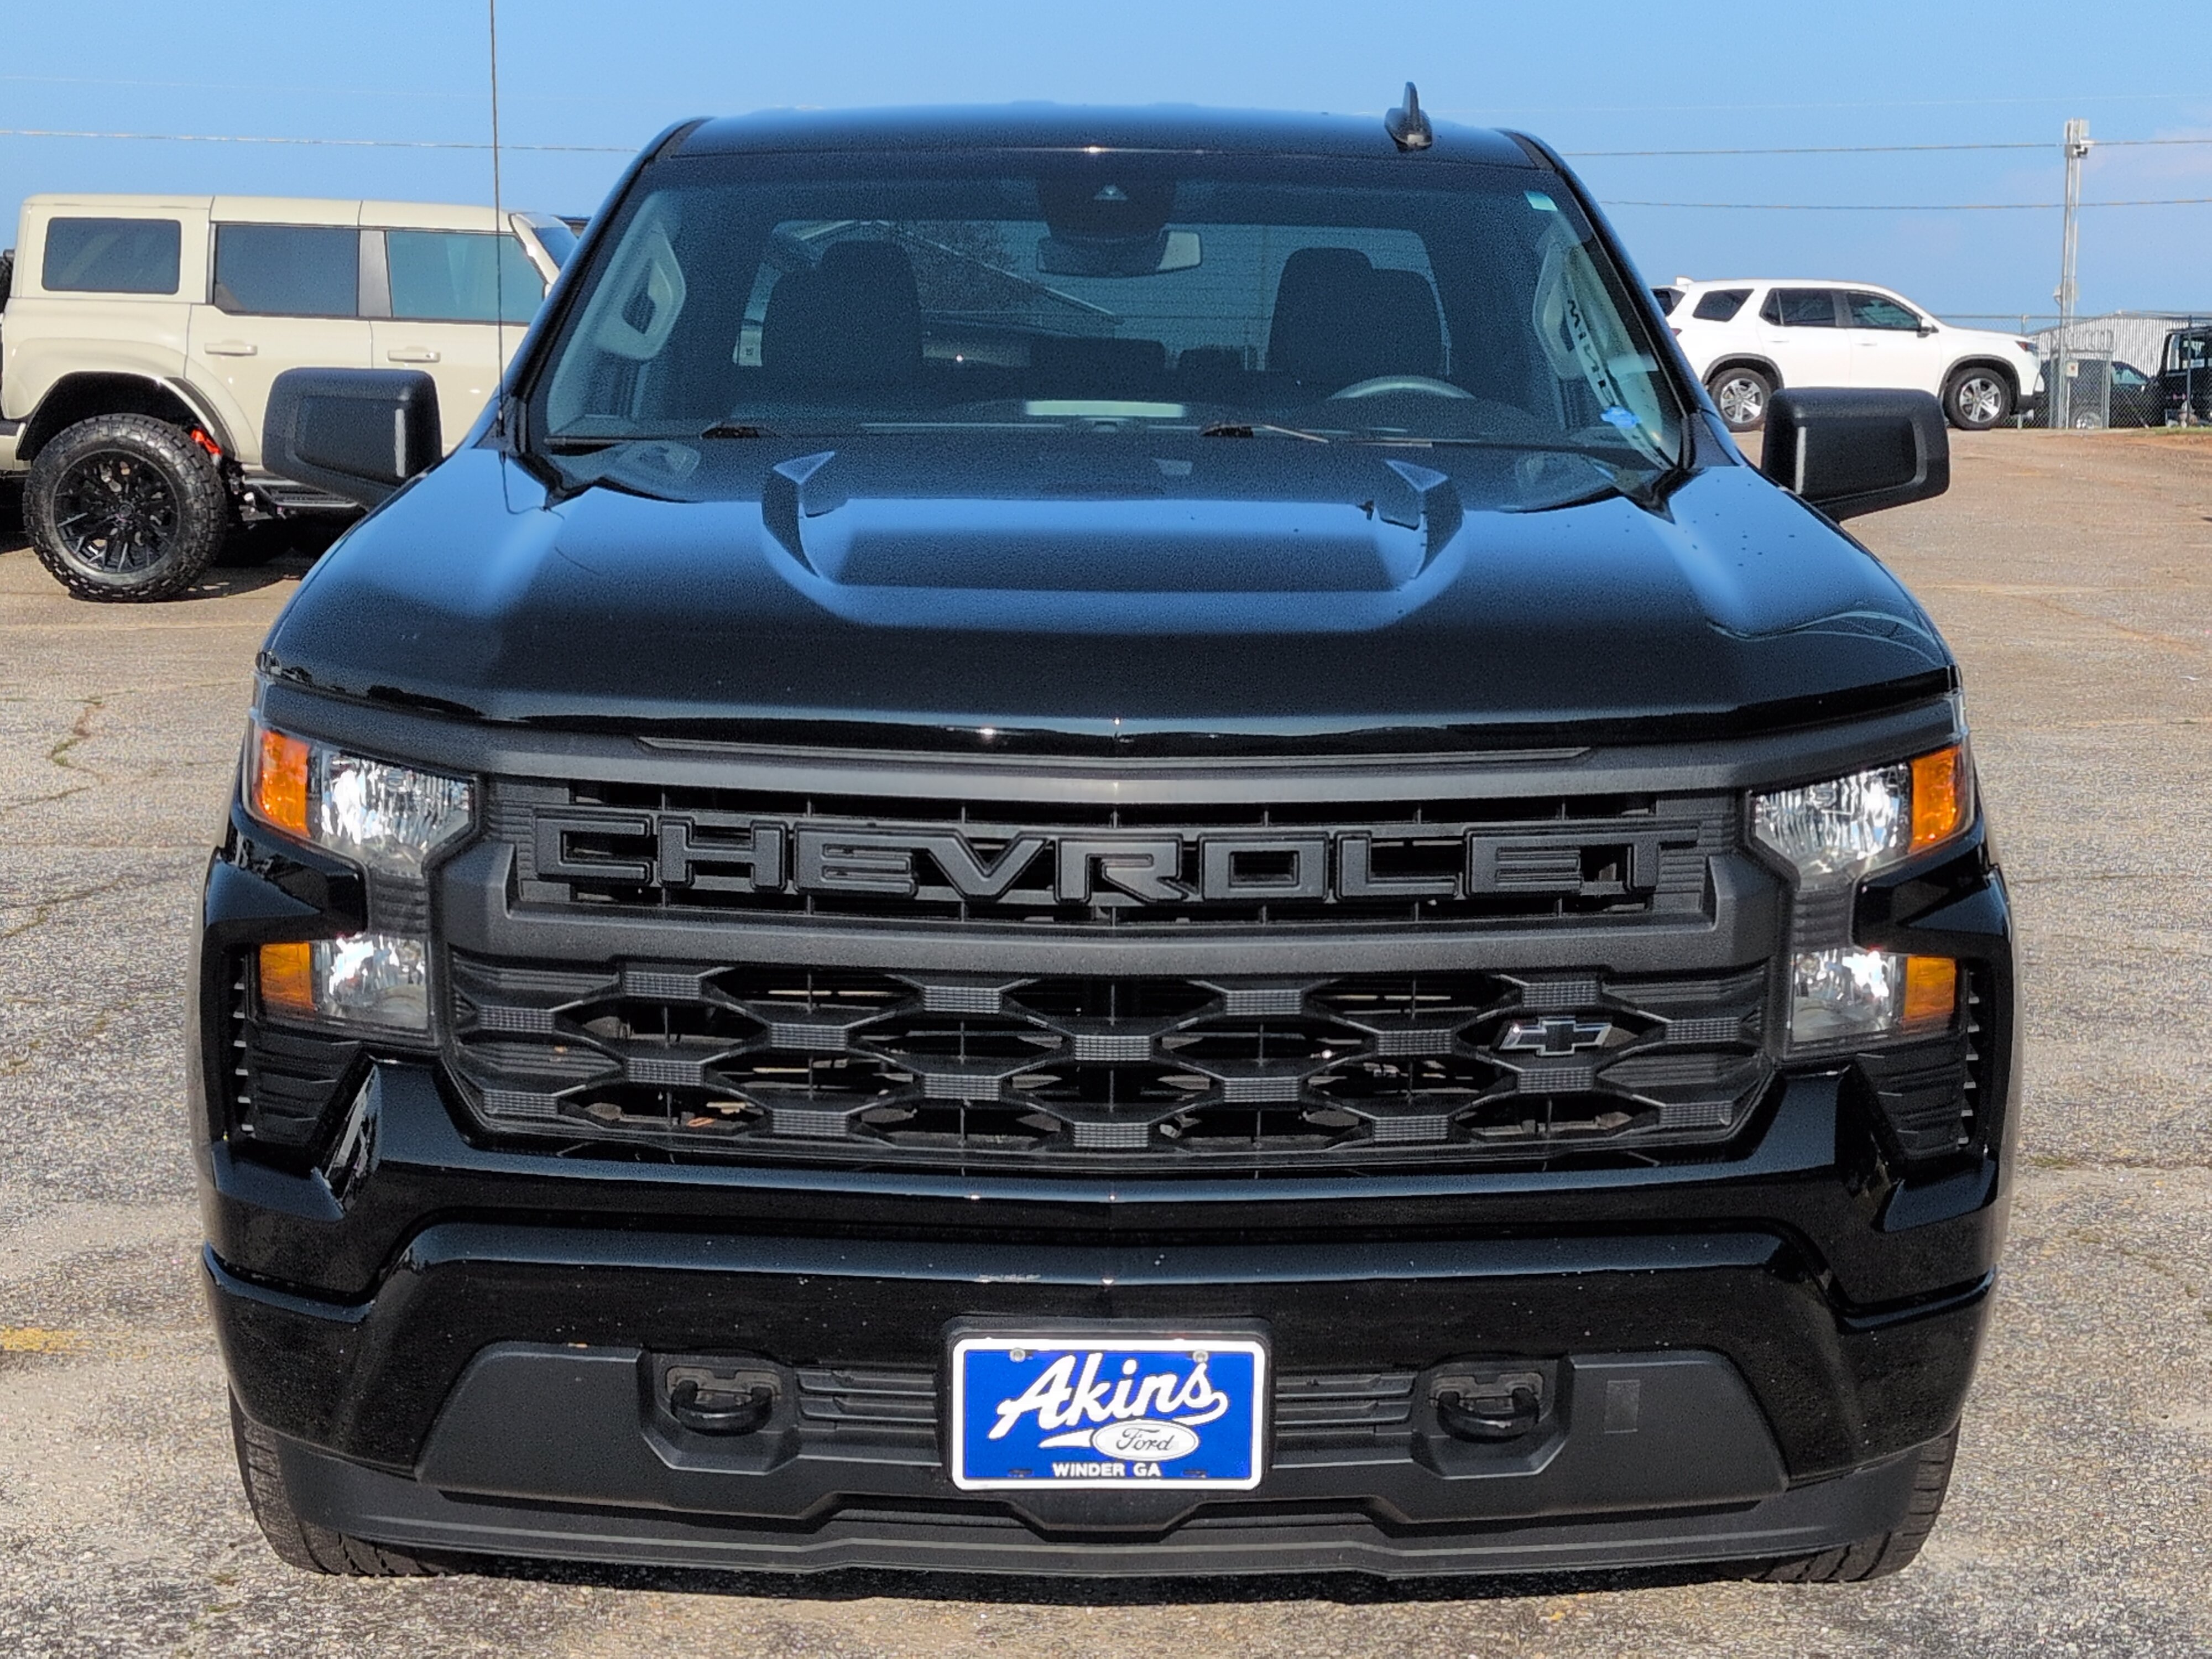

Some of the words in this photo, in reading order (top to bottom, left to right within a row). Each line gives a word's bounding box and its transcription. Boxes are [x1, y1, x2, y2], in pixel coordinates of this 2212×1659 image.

[535, 812, 1700, 904] CHEVROLET
[988, 1352, 1229, 1440] Akins
[1115, 1426, 1174, 1452] Ford
[1052, 1463, 1125, 1477] WINDER
[1133, 1463, 1161, 1477] GA
